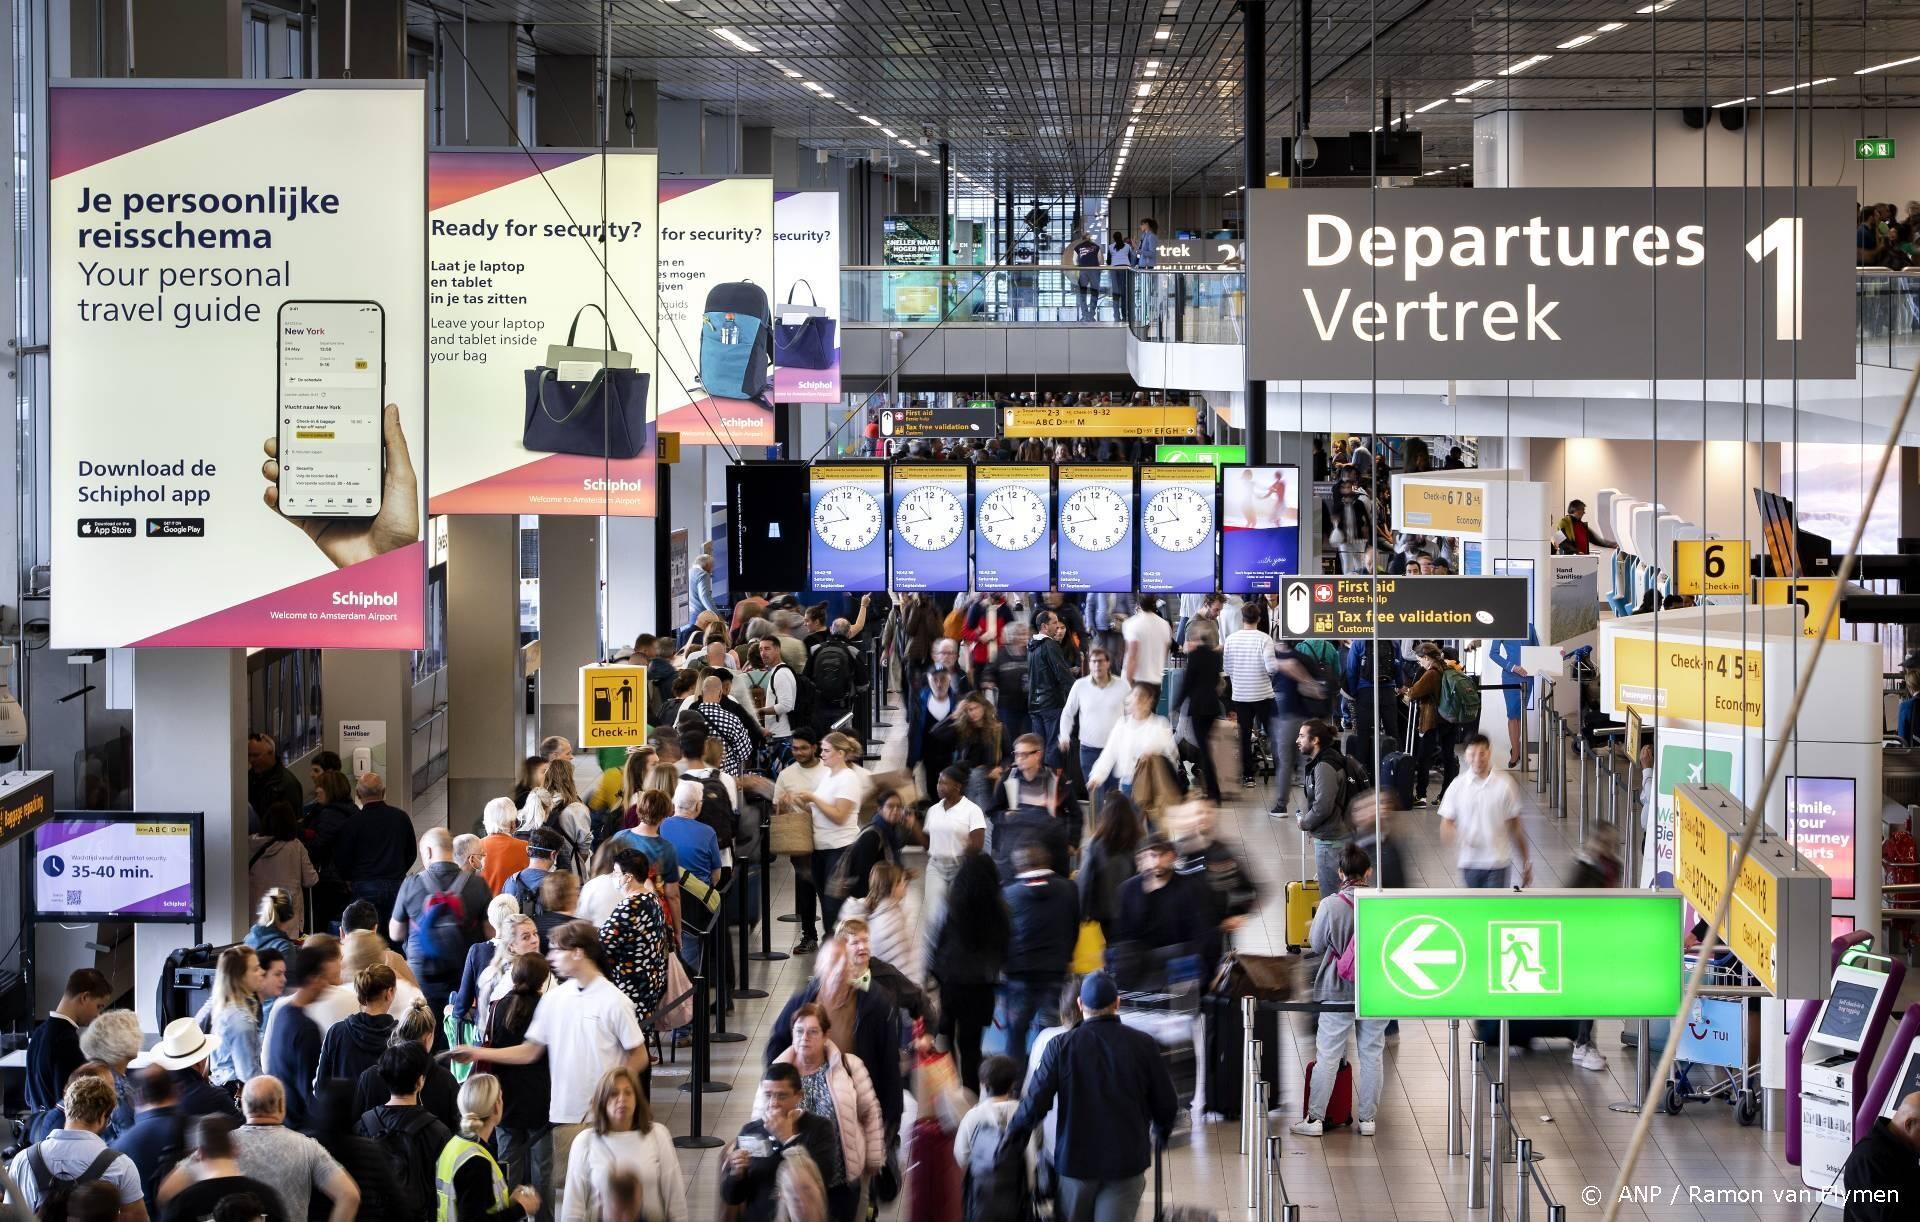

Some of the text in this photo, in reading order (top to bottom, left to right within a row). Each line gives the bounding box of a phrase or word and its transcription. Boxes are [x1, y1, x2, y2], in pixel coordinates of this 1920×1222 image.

[78, 186, 339, 221] Je persoonlijke
[78, 221, 272, 248] reisschema
[432, 219, 499, 241] Ready
[505, 219, 537, 237] for
[661, 228, 762, 243] for security?
[773, 230, 831, 243] security?
[1307, 214, 1705, 282] Departures
[1217, 244, 1237, 270] 2
[431, 260, 525, 275] Laat je laptop
[78, 261, 290, 292] Your personal
[431, 276, 493, 288] en tablet
[670, 271, 705, 280] mogen
[1746, 217, 1803, 341] 1
[431, 293, 527, 307] in je tas zitten
[78, 296, 261, 328] travel guide
[1302, 284, 1562, 341] Vertrek
[431, 317, 545, 331] Leave your laptop
[430, 333, 537, 346] and tablet inside
[430, 350, 487, 364] your bag
[798, 381, 832, 390] Schiphol
[721, 418, 763, 429] Schiphol
[79, 459, 217, 477] Download de
[583, 479, 641, 493] Schiphol
[78, 484, 211, 506] Schiphol app
[529, 495, 562, 503] Welcome
[573, 496, 613, 504] Amsterdam
[615, 497, 641, 505] Airport
[1424, 491, 1472, 506] Check-in 6 7 8
[1456, 516, 1481, 526] Economy
[94, 526, 132, 535] App Store
[163, 526, 201, 534] Google Play
[1705, 545, 1726, 578] 6
[1338, 580, 1395, 593] First aid
[1704, 581, 1740, 590] Check-in
[332, 591, 398, 608] Schiphol
[1338, 595, 1388, 605] Eerste hlp
[270, 612, 398, 622] Welcome to Amsterdam Airport
[1337, 610, 1361, 622] Tax
[1399, 610, 1472, 624] validation
[1338, 625, 1375, 633] Customs
[1671, 654, 1743, 680] Check-in 4 5
[1715, 696, 1761, 716] Economy
[592, 727, 637, 737] Check-in
[1658, 808, 1674, 823] We
[1789, 801, 1837, 816] Smile,
[1656, 825, 1673, 841] Bie
[72, 865, 153, 878] 35-40 min.
[1758, 875, 1767, 914] 1-8
[1713, 1031, 1729, 1041] TUI
